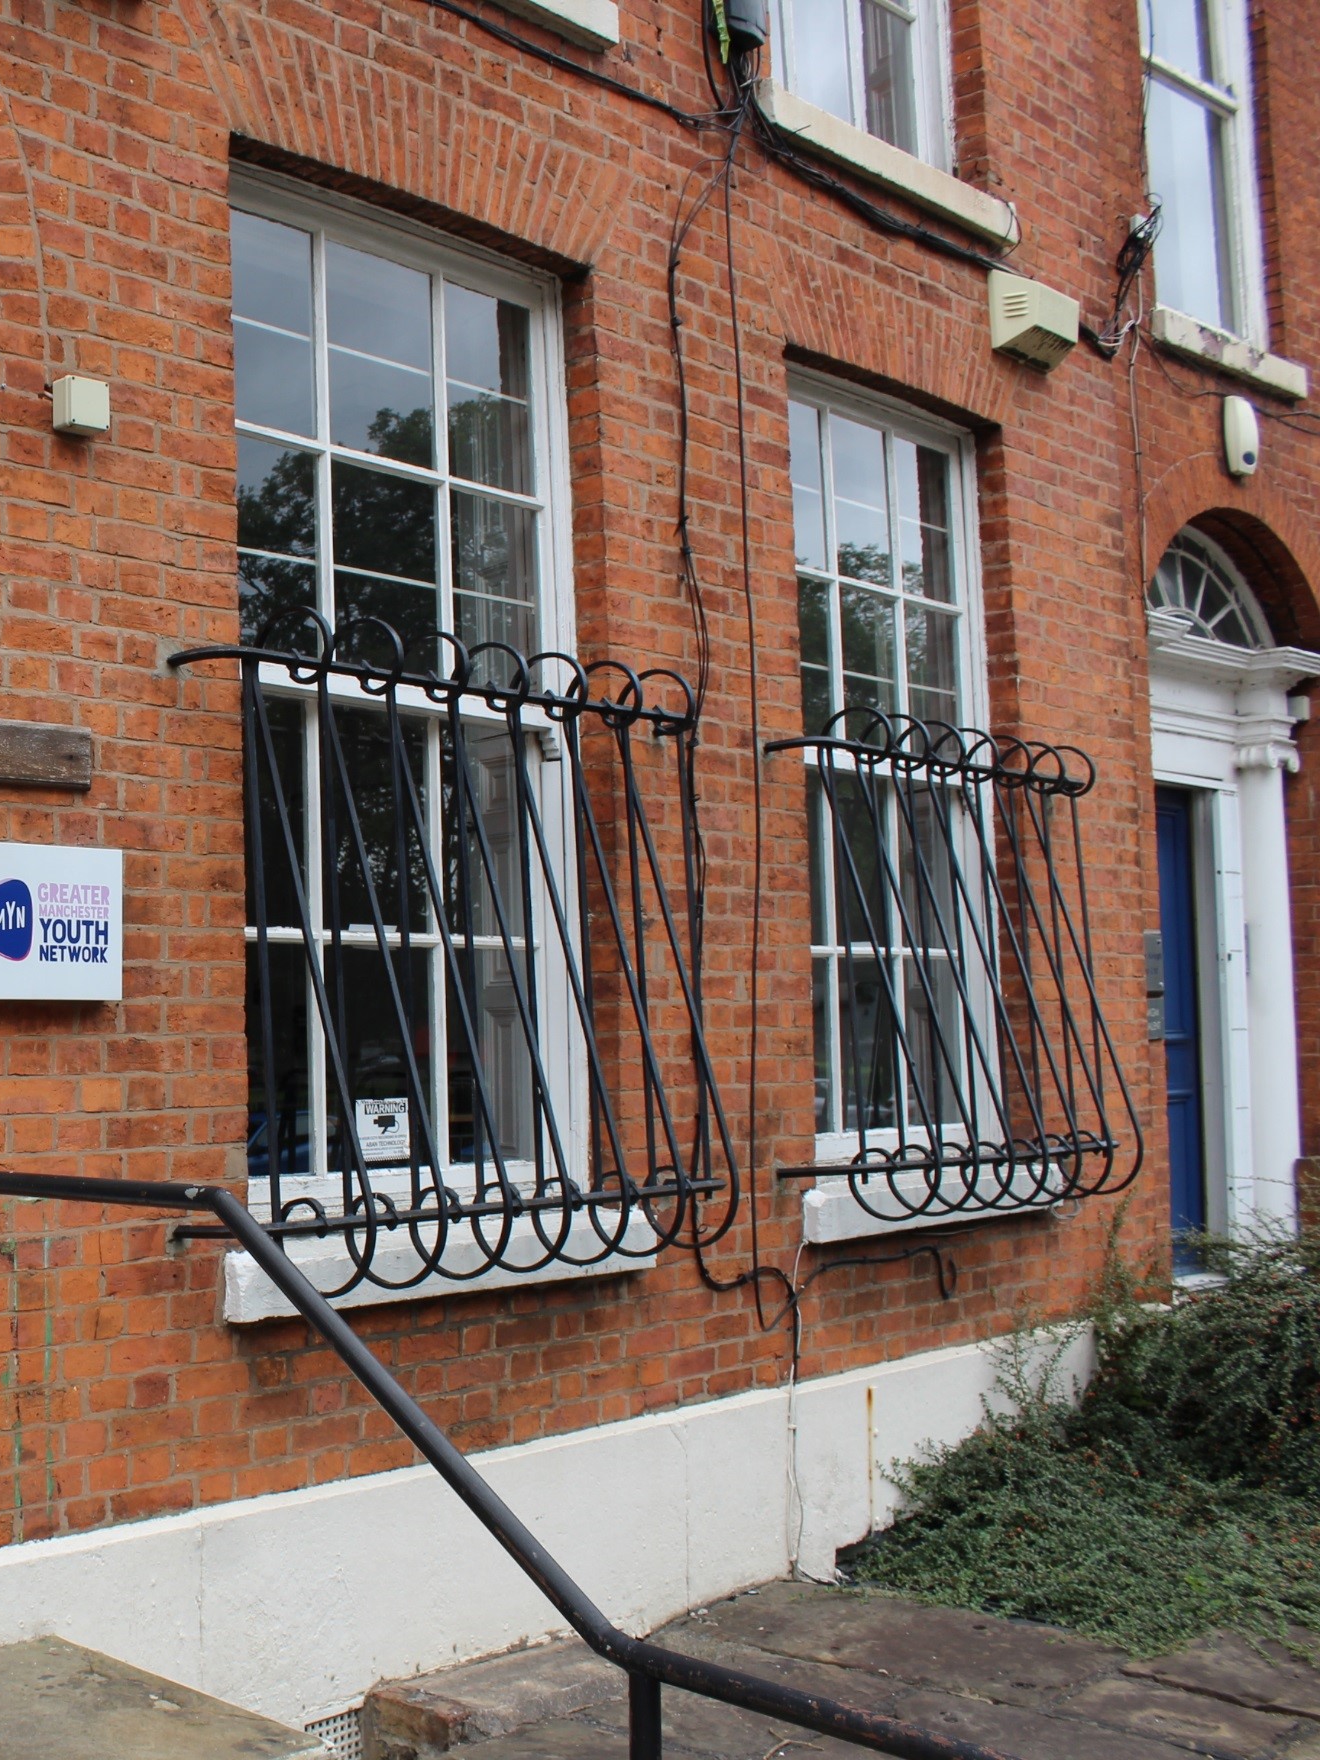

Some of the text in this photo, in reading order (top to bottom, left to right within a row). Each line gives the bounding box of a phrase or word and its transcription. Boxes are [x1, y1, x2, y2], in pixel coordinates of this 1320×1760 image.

[37, 883, 110, 905] GREATER
[38, 904, 109, 919] MANCHESTER
[39, 918, 109, 945] YOUTH
[39, 945, 108, 963] NETWORK
[365, 1103, 405, 1114] WARNING
